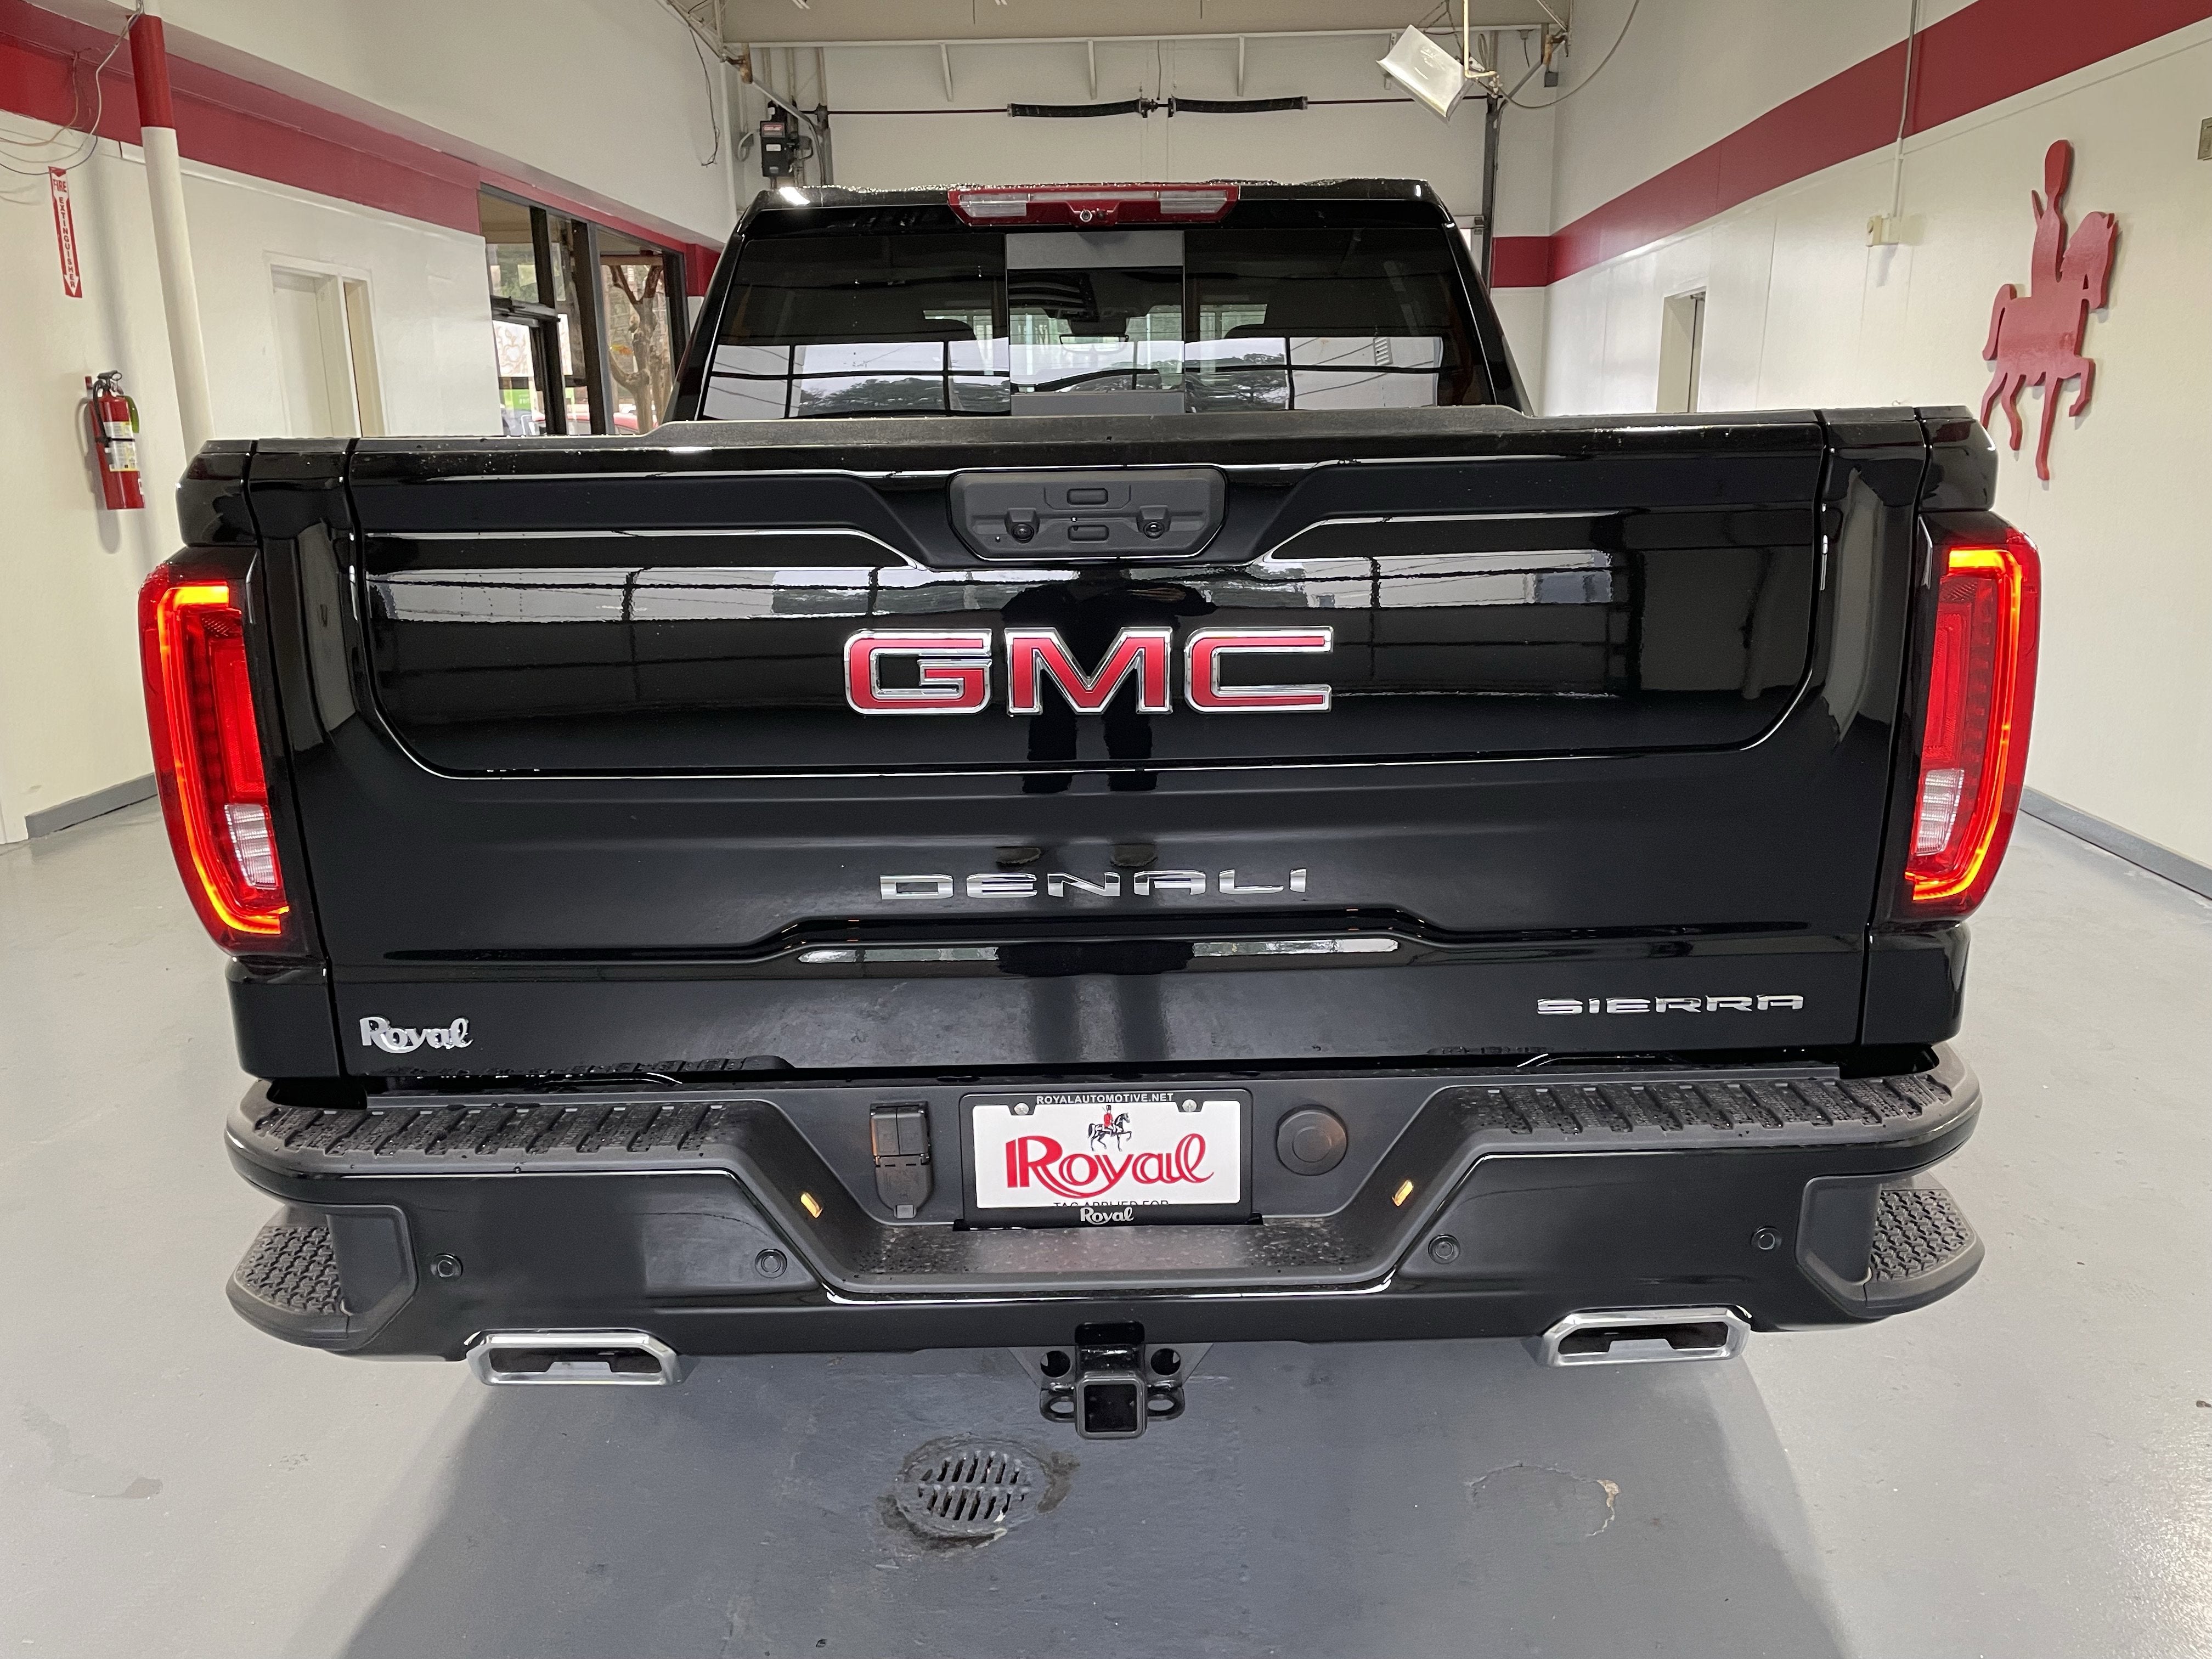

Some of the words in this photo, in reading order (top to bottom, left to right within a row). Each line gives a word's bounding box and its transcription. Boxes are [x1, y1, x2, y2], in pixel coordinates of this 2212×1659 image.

[52, 179, 67, 193] FIRE
[59, 197, 75, 288] EXTINGUISHER
[844, 627, 1334, 715] GMC
[880, 869, 1307, 900] DENALI
[1537, 995, 1804, 1015] SIERRA
[359, 1016, 474, 1054] Royal
[1036, 1093, 1174, 1104] ROYALAUTOMOTIVE.NET
[1006, 1133, 1215, 1198] Royal
[1080, 1206, 1134, 1225] Royal
